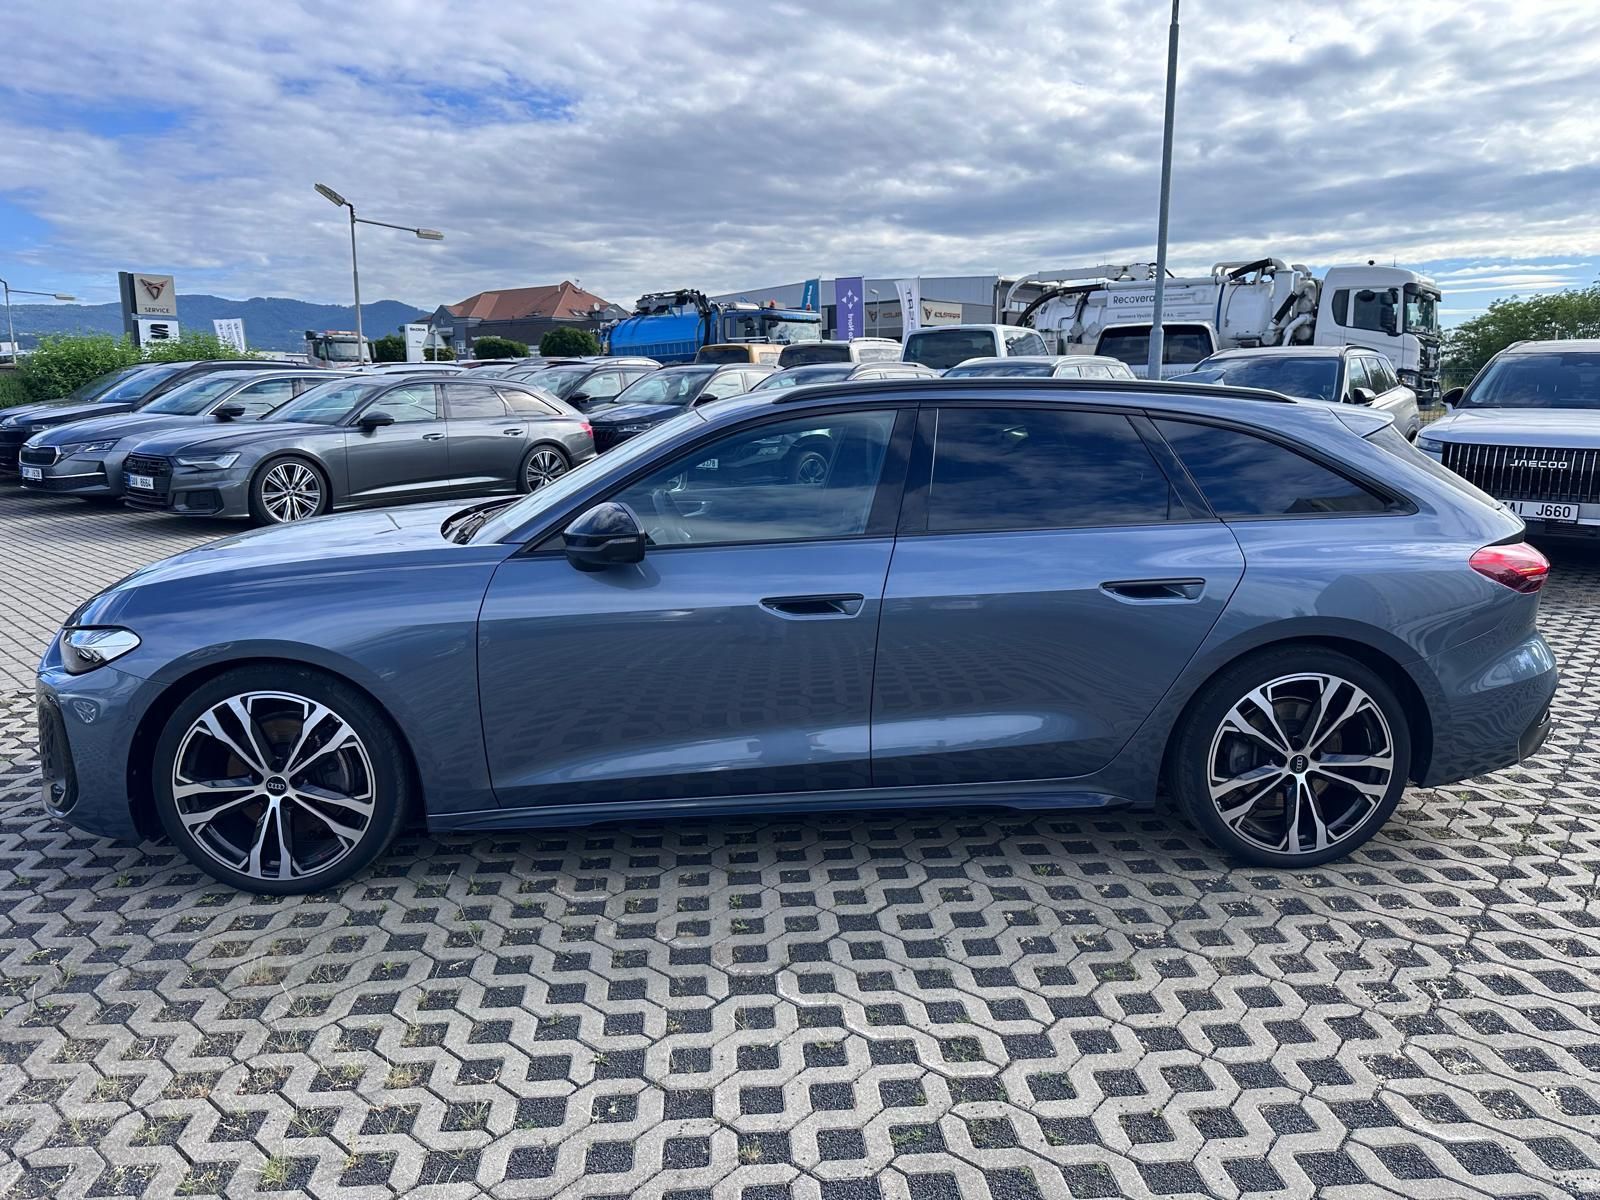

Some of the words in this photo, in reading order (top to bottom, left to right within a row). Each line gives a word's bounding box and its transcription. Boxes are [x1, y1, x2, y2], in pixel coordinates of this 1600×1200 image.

[144, 306, 170, 314] SERVICE
[1509, 459, 1568, 469] JAECOO
[1535, 504, 1571, 518] J660
